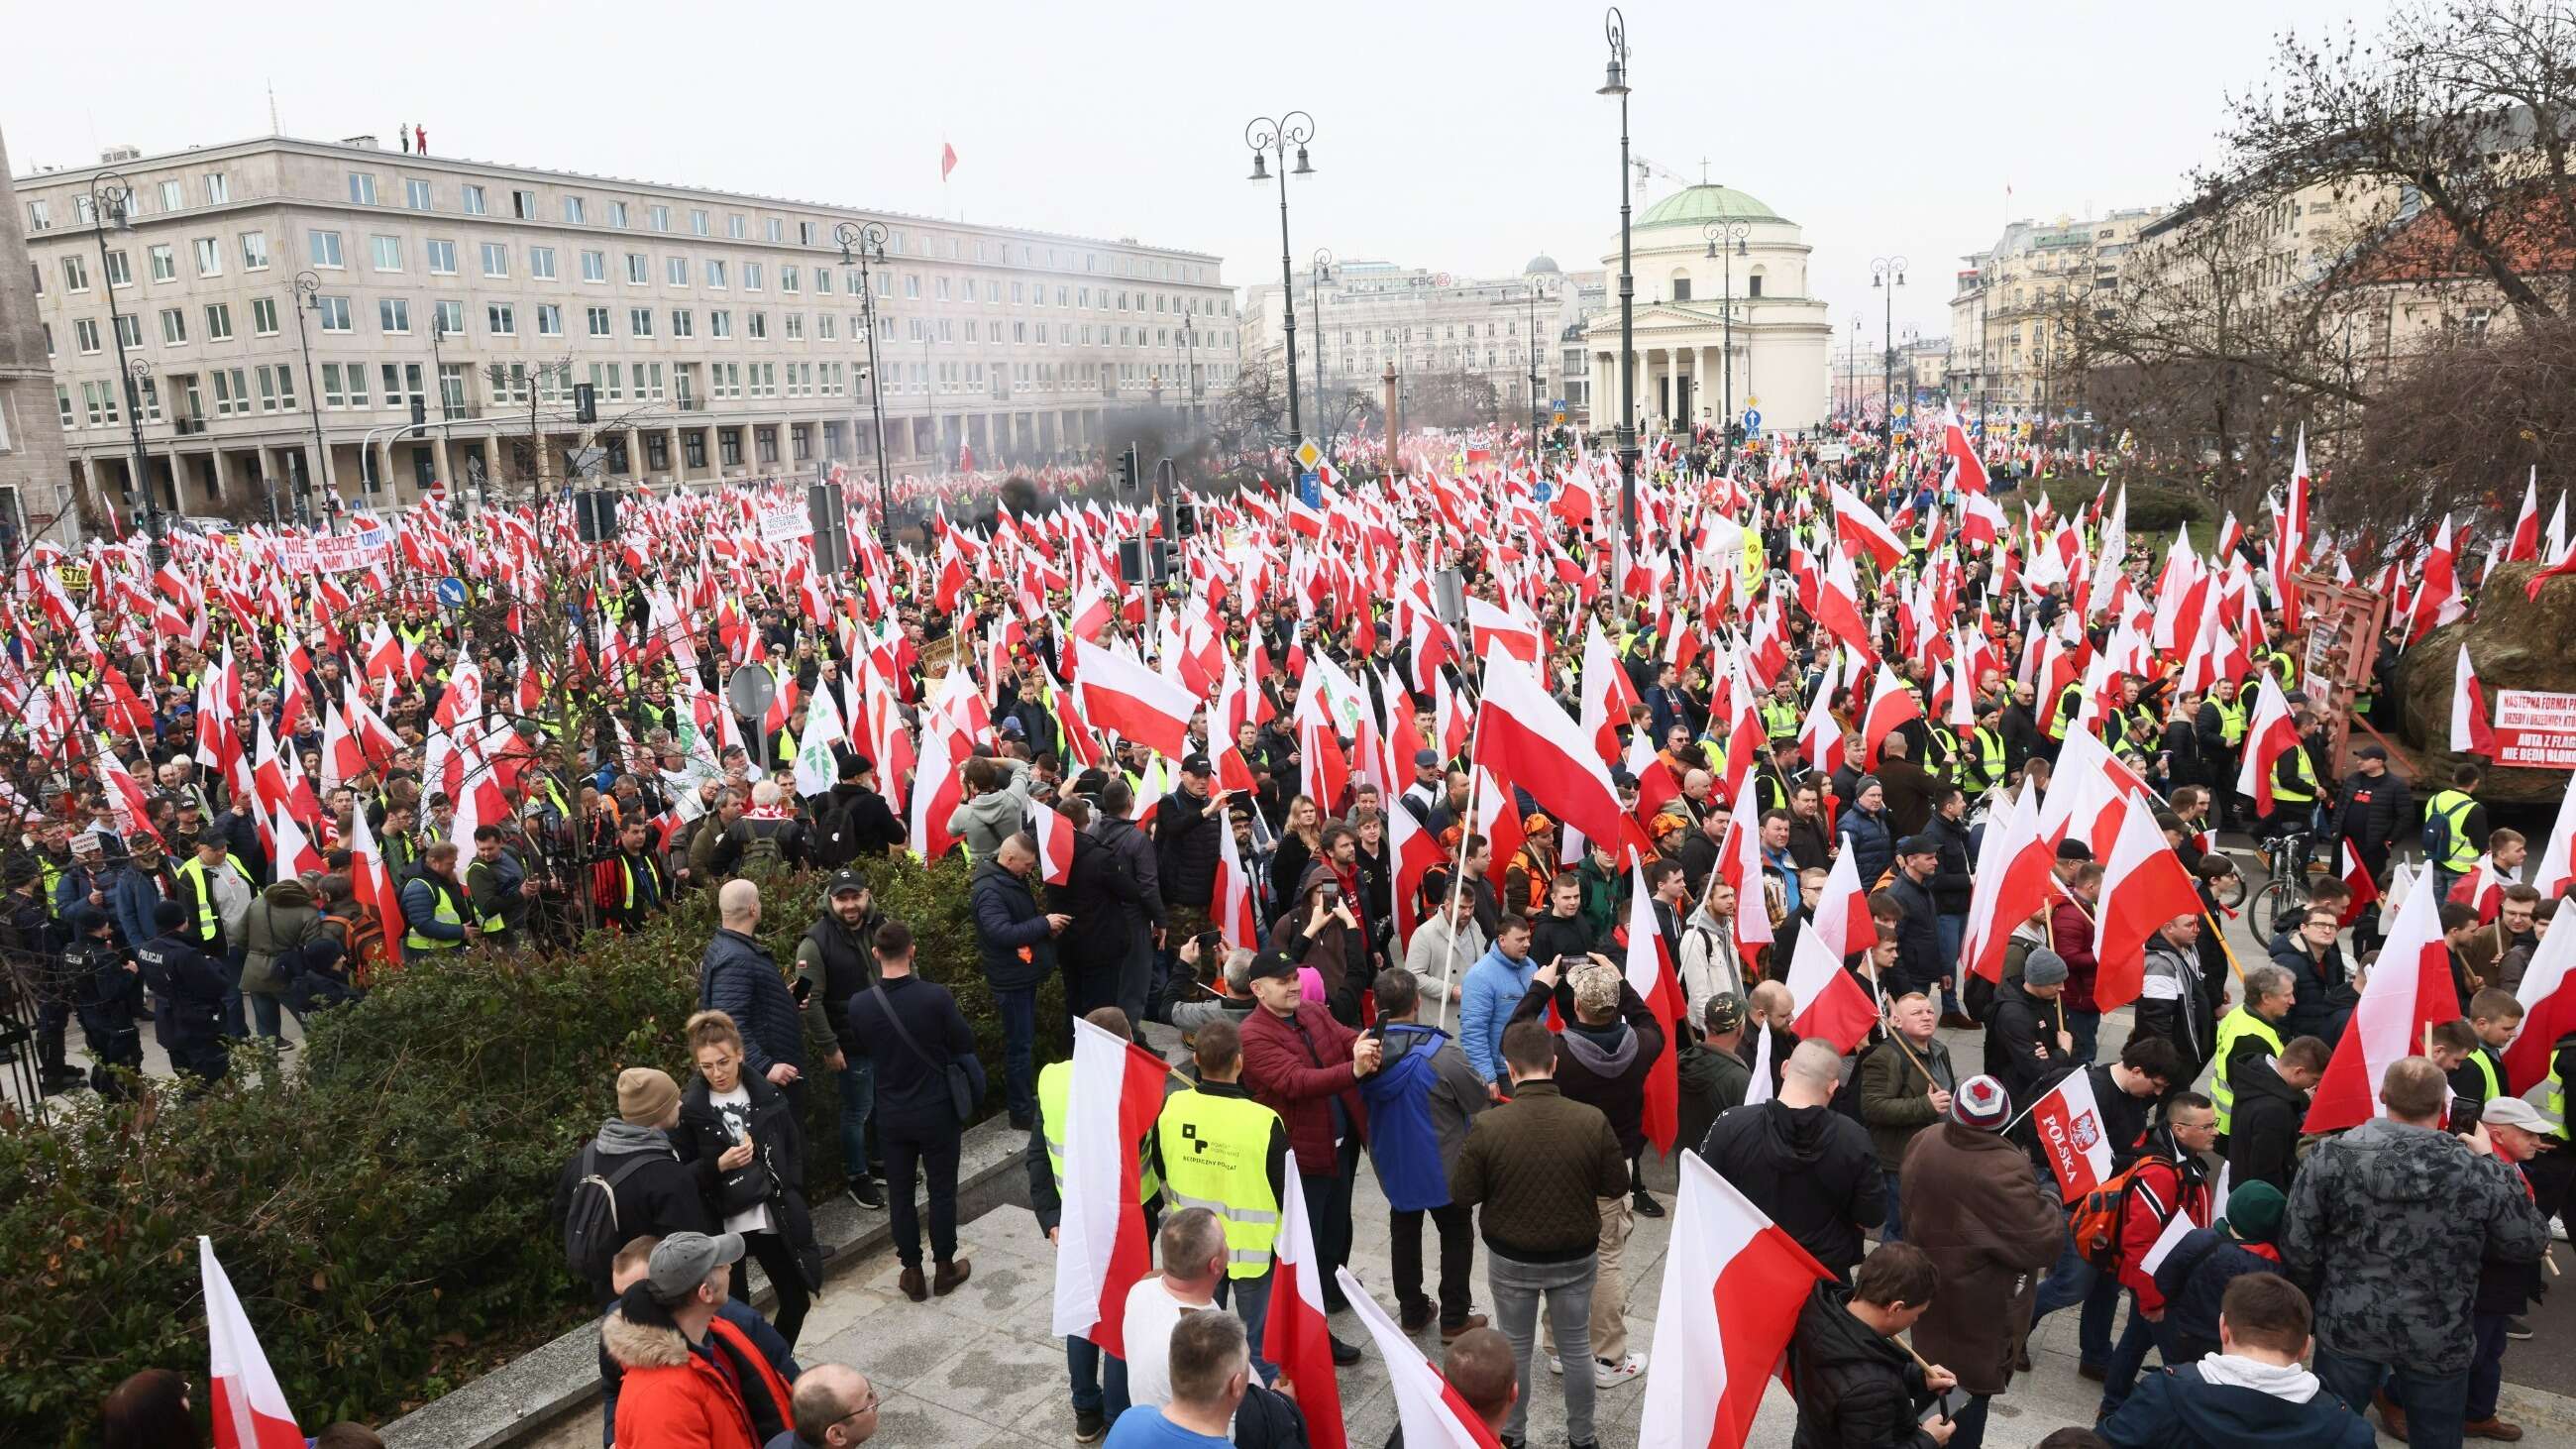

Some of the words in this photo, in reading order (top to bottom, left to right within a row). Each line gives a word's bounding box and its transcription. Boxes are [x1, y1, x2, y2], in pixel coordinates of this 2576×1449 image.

[767, 502, 797, 517] STOP
[285, 538, 309, 554] NIE
[315, 535, 358, 555] BĘDZIE
[323, 555, 345, 570] NAM
[351, 552, 362, 566] W
[62, 567, 89, 582] STO
[2541, 697, 2567, 711] FORMA
[2518, 733, 2543, 746] AUTA
[2543, 734, 2551, 747] Z
[2502, 747, 2519, 760] NIE
[2519, 747, 2545, 763] BĘDĄ
[139, 948, 163, 965] POLICJA
[2042, 1113, 2078, 1184] POLSKA
[1182, 1155, 1217, 1167] BEZPIECZNY
